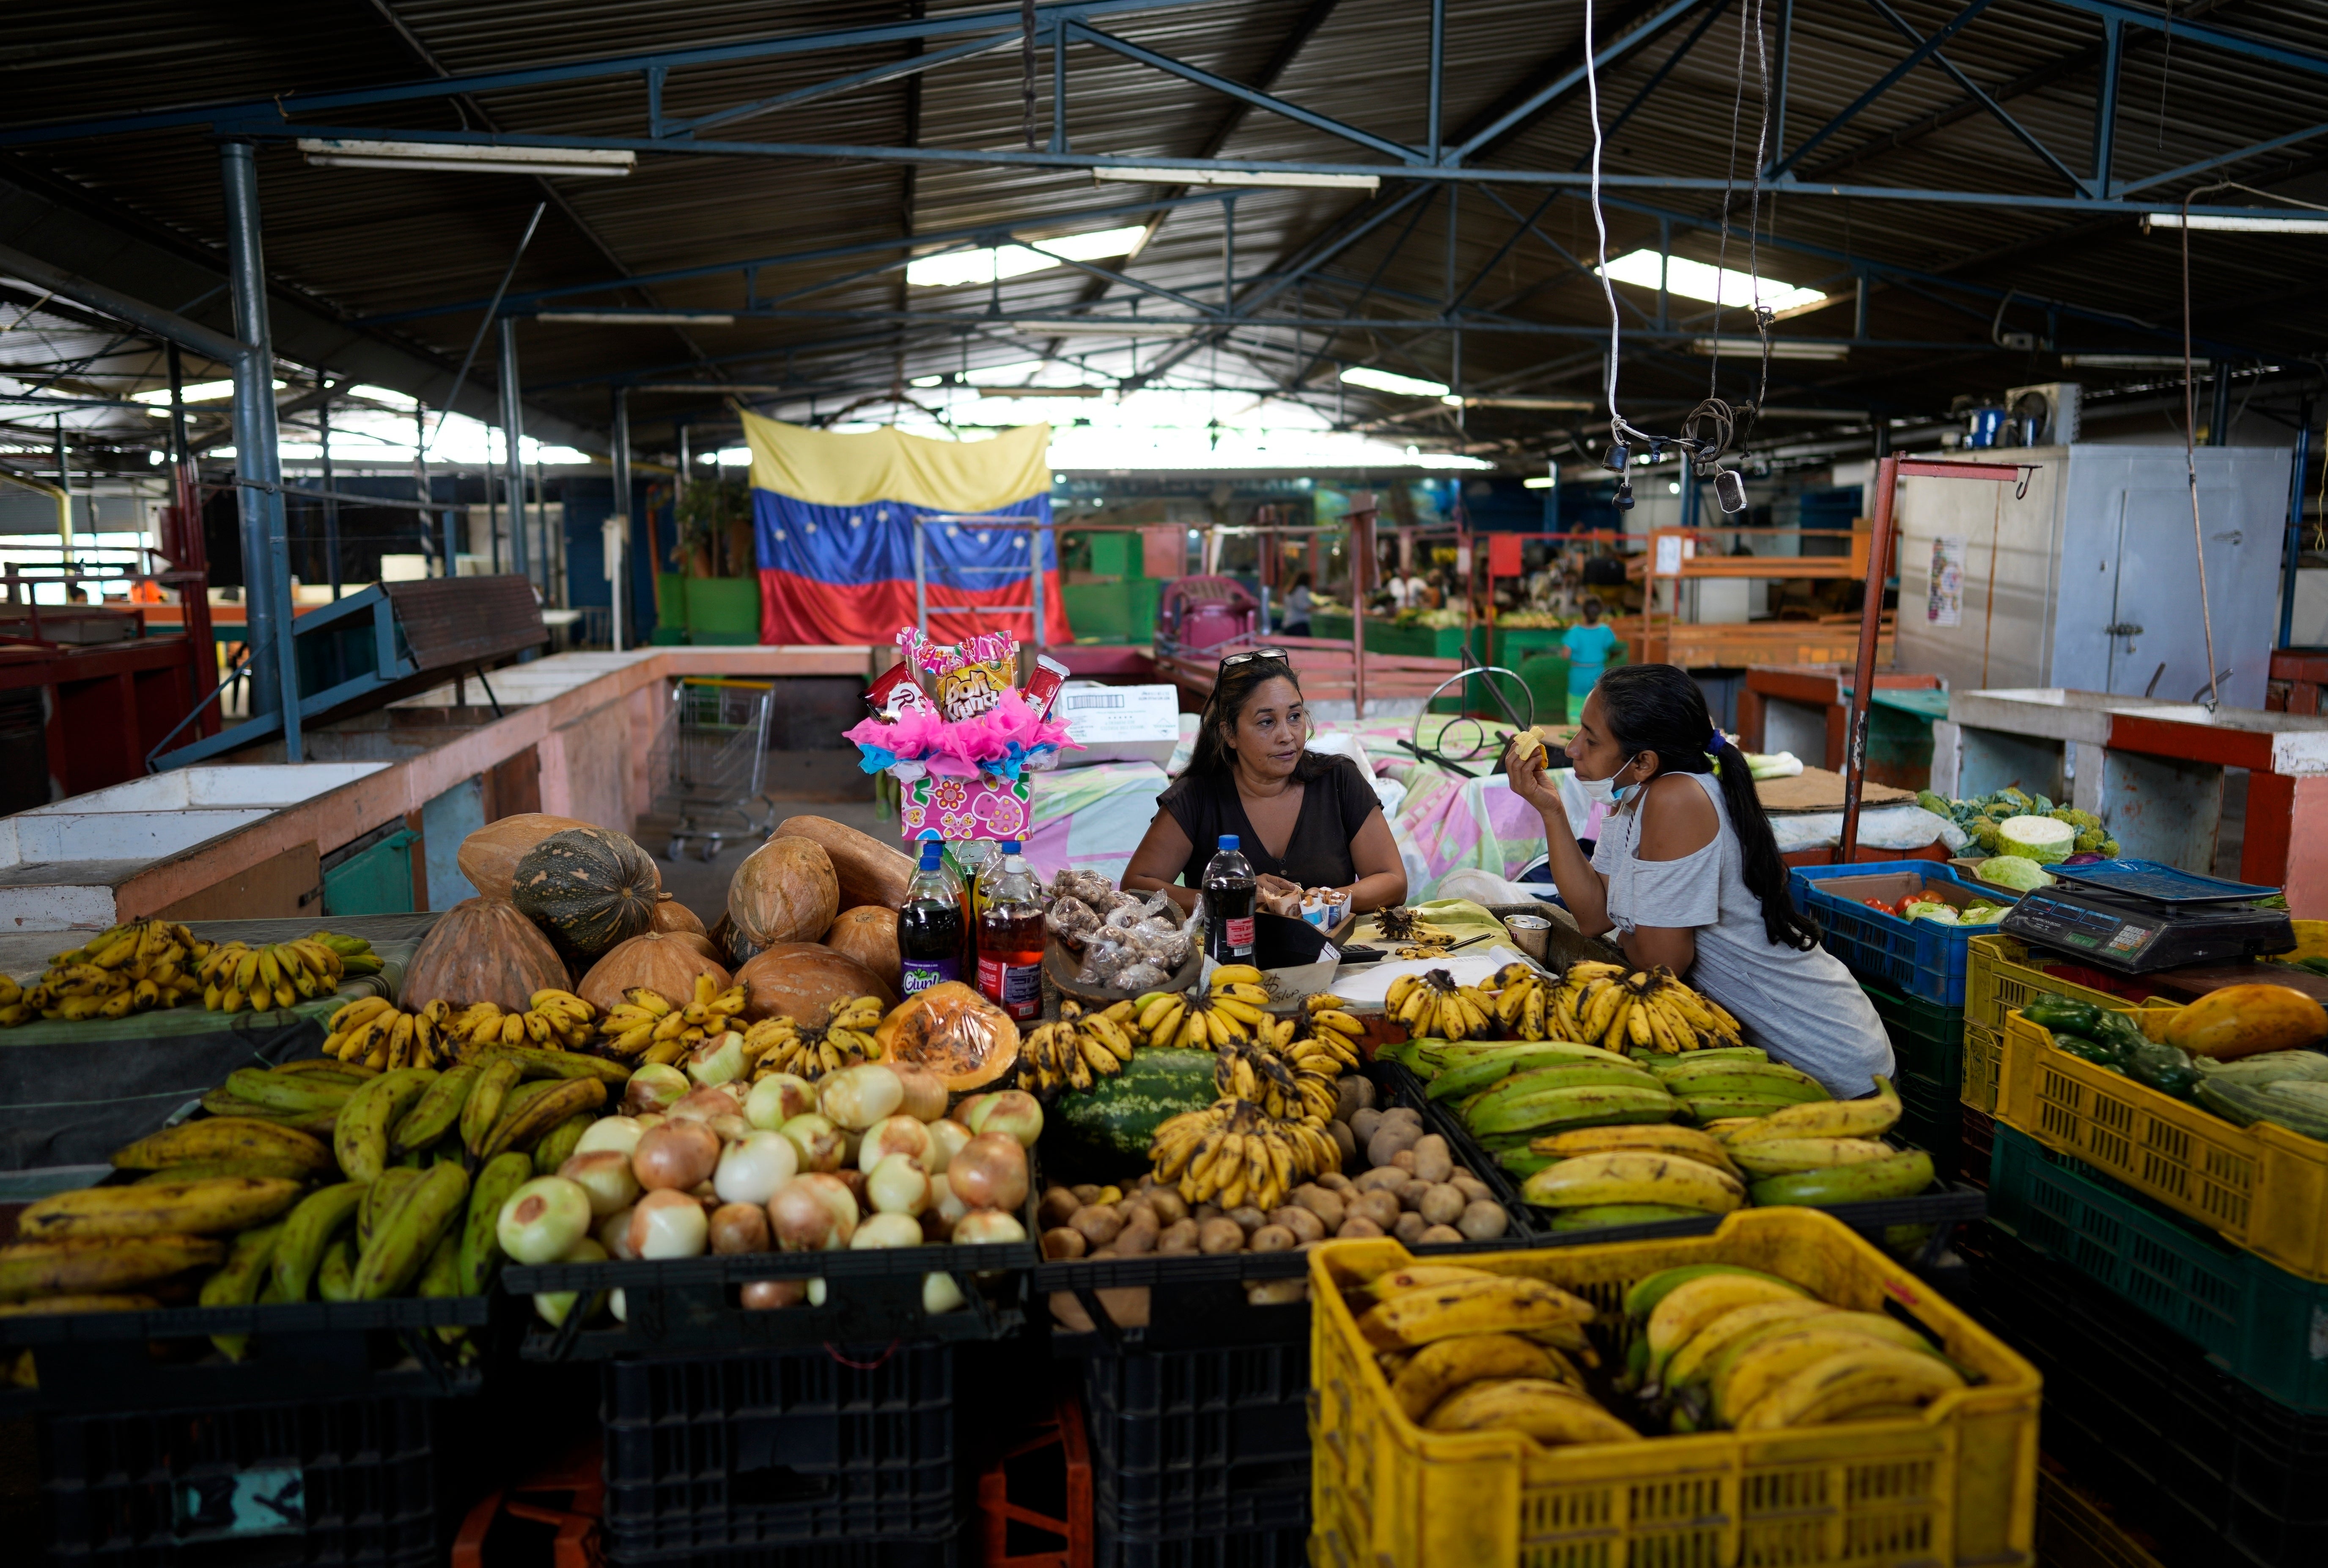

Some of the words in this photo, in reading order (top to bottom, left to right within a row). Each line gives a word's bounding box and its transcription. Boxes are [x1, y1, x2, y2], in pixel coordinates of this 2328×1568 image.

[945, 670, 991, 705] Boli
[942, 690, 999, 721] Krunch
[2031, 916, 2051, 925] AMERICAN
[1327, 945, 1339, 958] ALUD
